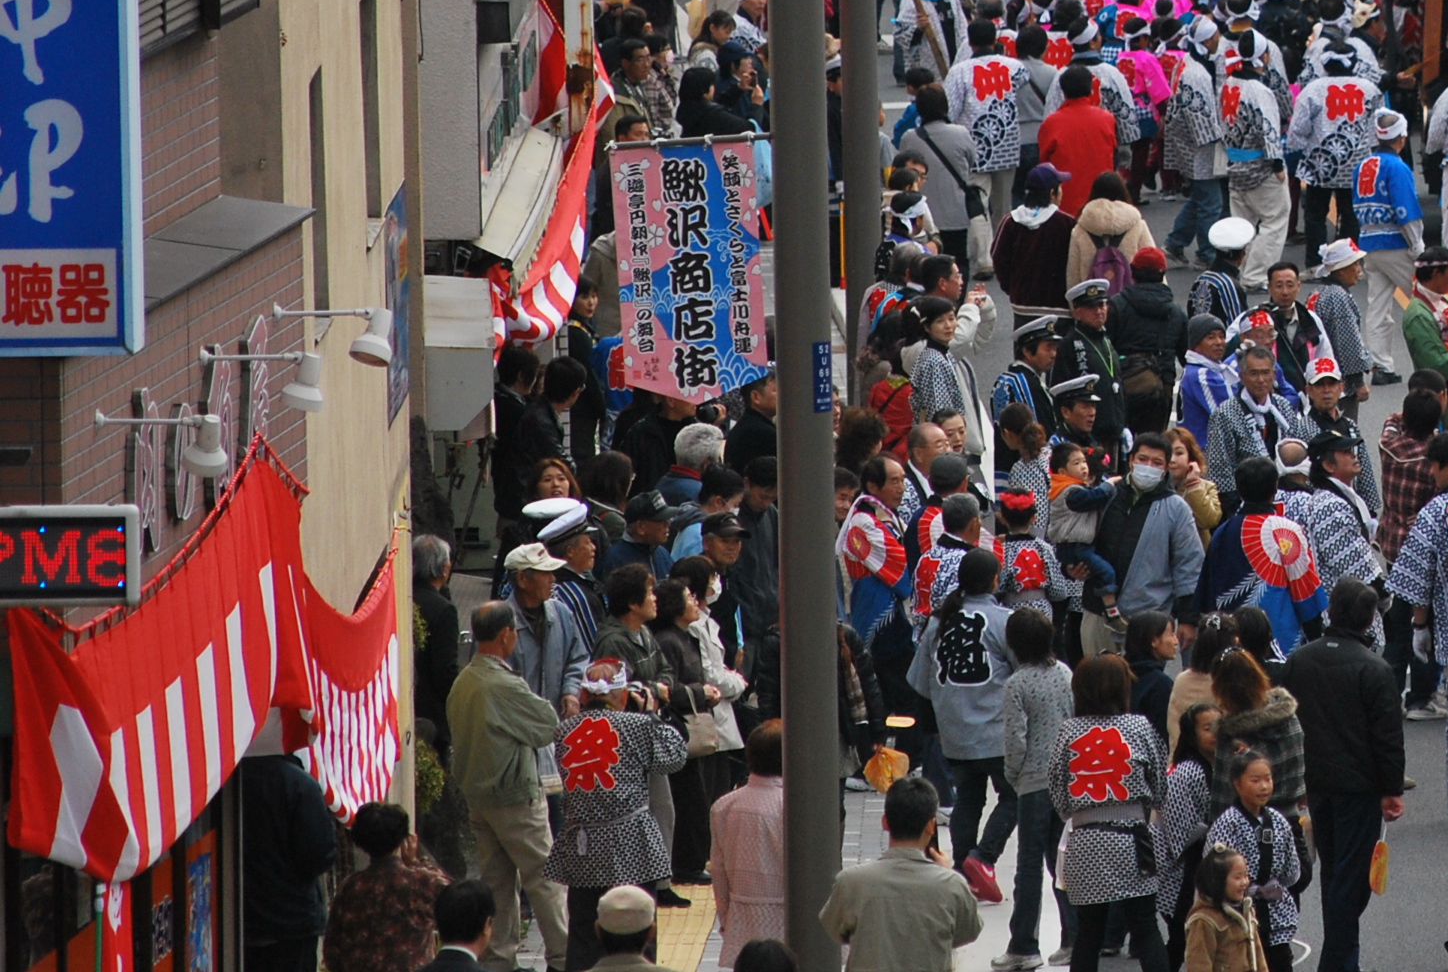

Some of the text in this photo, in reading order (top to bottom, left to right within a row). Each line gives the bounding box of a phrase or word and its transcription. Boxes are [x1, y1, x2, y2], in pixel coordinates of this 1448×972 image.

[627, 163, 655, 353] 三遊亭円朝作『鰍沢』の舞台
[660, 158, 719, 390] 鰍沢商店街
[721, 154, 752, 354] 笑顔とさくらと富士川舟運
[1, 261, 110, 326] 聴器
[818, 344, 829, 355] 52
[561, 716, 620, 792] 祭
[1068, 726, 1133, 803] 祭
